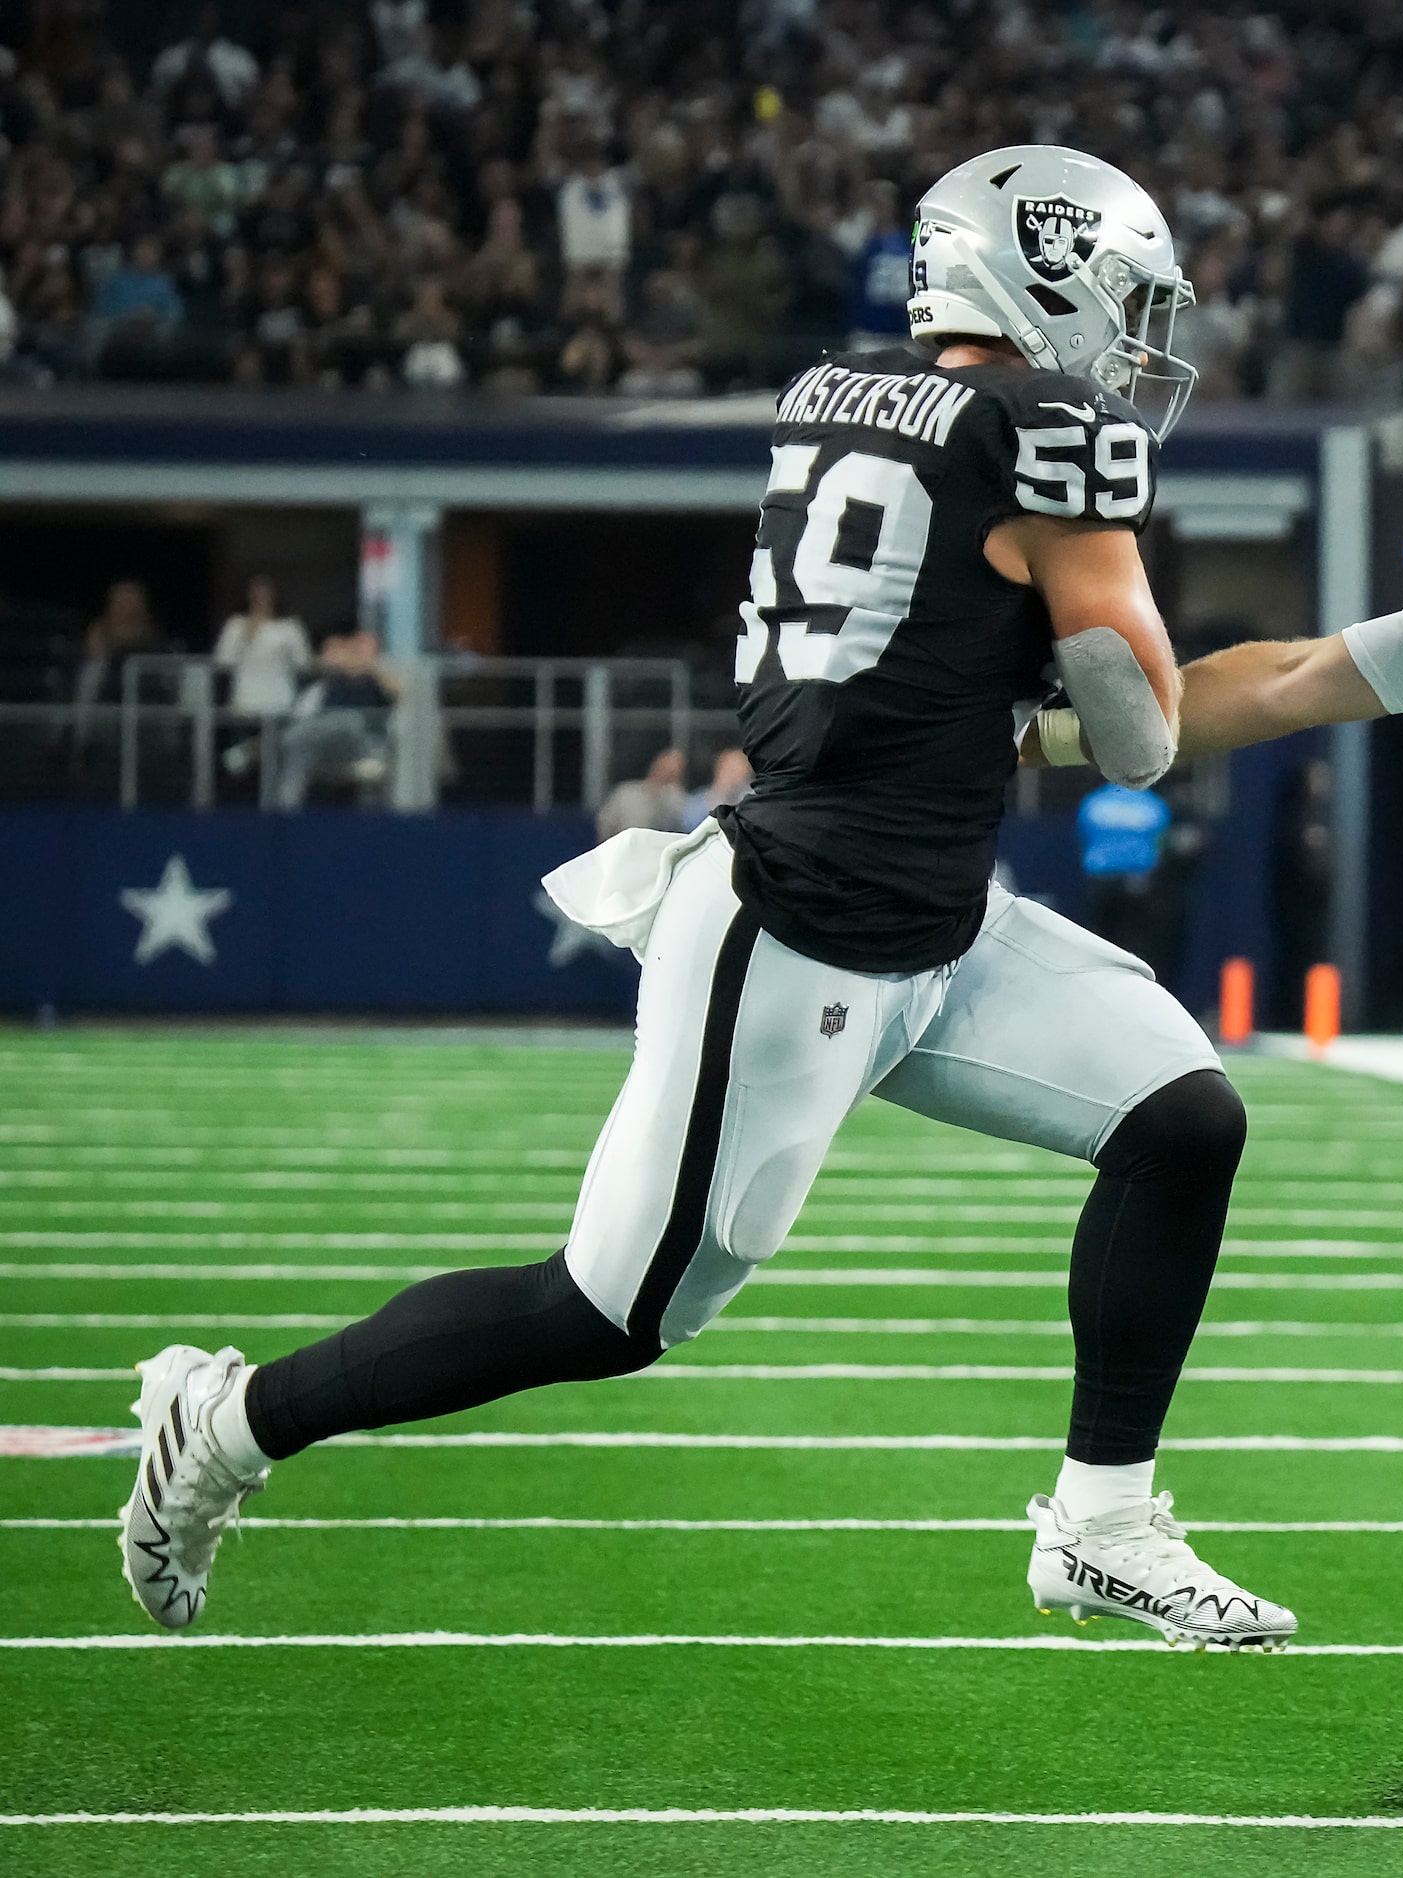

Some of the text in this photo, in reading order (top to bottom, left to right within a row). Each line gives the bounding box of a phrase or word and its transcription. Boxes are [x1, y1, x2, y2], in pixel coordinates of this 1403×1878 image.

[1025, 201, 1095, 221] RAIDERS
[1015, 422, 1149, 520] 59
[734, 443, 934, 686] 59
